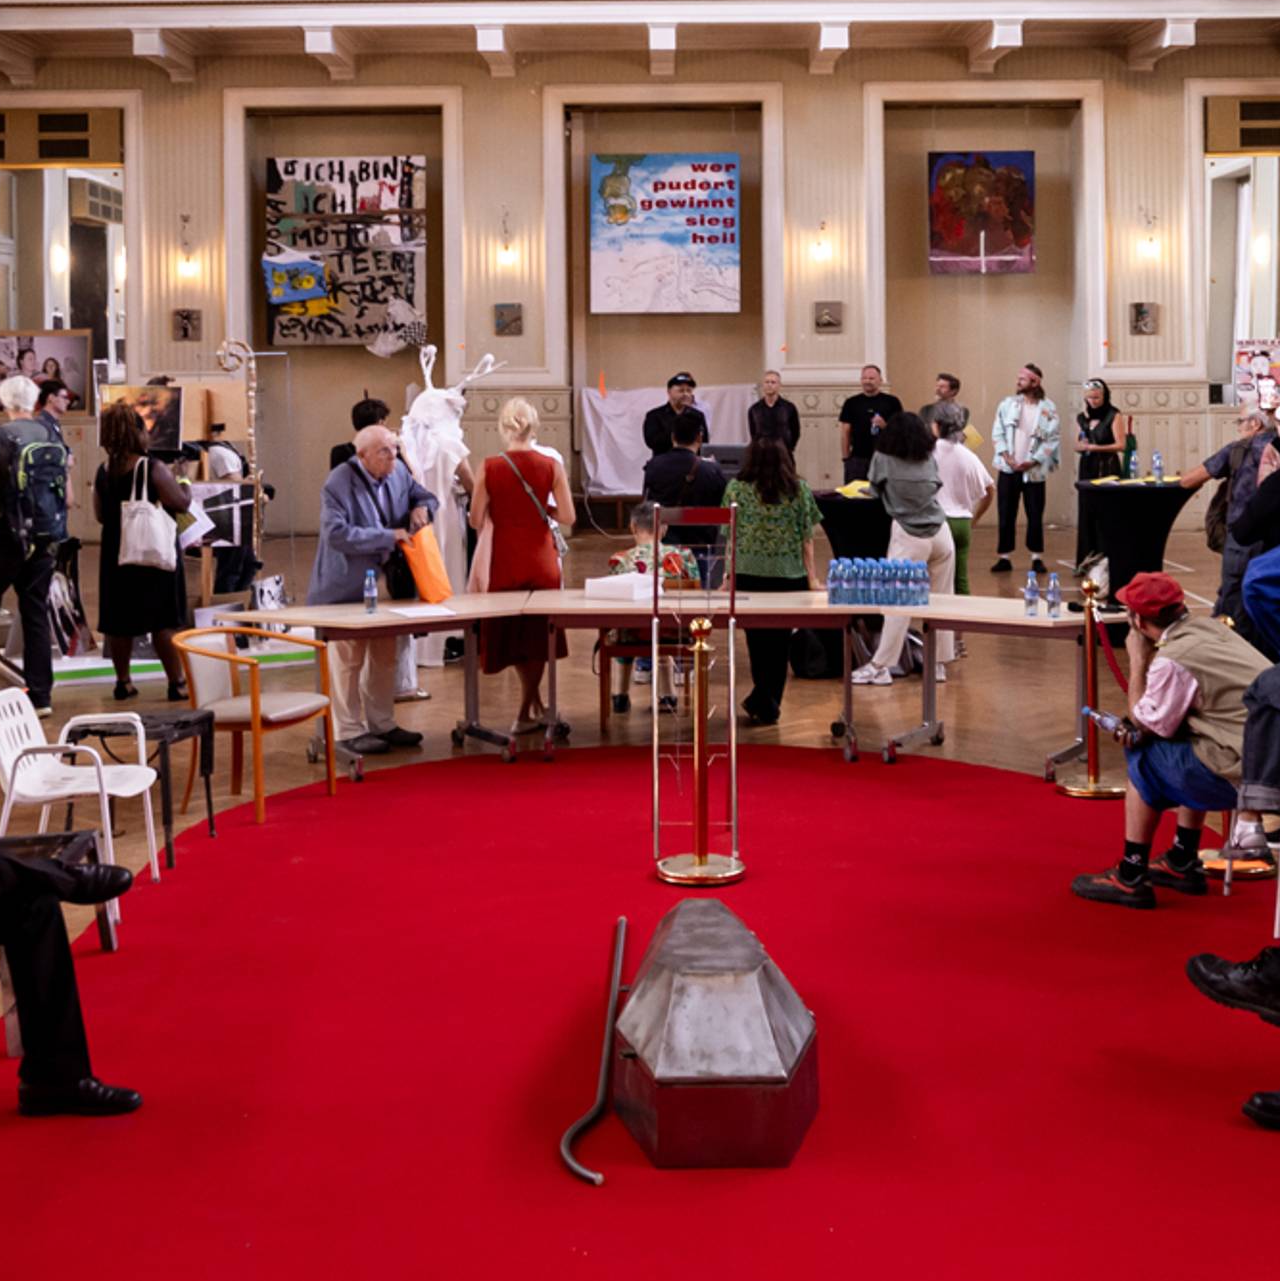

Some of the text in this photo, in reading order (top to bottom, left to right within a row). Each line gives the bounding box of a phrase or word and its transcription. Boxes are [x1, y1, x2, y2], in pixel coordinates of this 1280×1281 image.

[304, 156, 399, 183] ICH BIN
[691, 162, 736, 173] wer
[652, 179, 736, 193] pudert
[303, 193, 346, 215] ICH
[640, 196, 736, 211] gewinnt
[685, 214, 736, 228] sieg
[691, 232, 736, 245] heil
